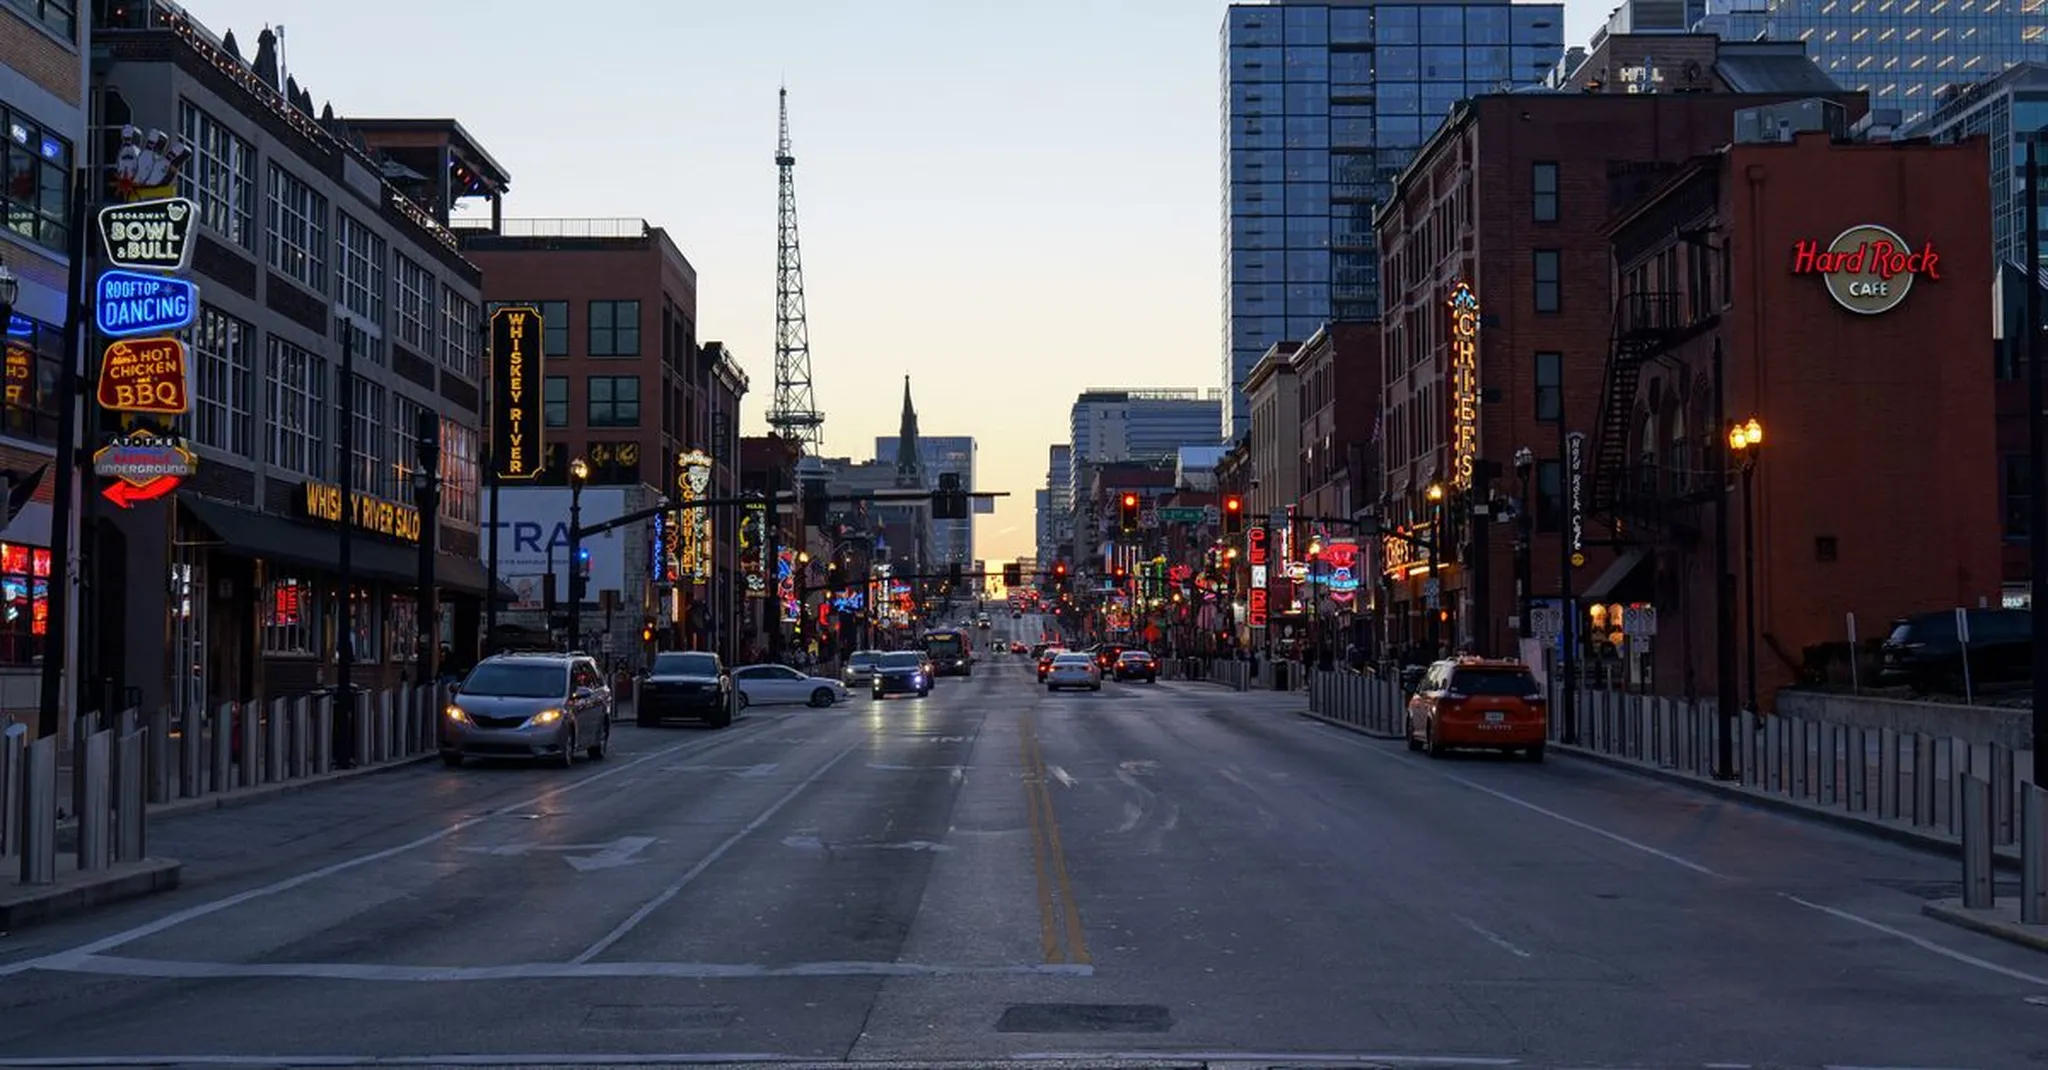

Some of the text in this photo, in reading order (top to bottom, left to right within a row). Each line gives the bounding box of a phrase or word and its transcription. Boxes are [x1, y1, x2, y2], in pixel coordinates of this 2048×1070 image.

[110, 221, 180, 241] BOWL
[117, 241, 179, 259] & BULL
[1793, 239, 1940, 280] Hard Rock
[105, 280, 160, 299] ROOFTOP
[1849, 281, 1889, 297] CAFE
[105, 295, 187, 326] DANCING
[140, 347, 173, 362] HOT
[110, 361, 177, 378] CHICKEN
[114, 381, 179, 407] BBQ
[508, 313, 525, 474] WHISKEY RIVER
[1457, 313, 1476, 477] CHIEFS
[111, 437, 174, 446] AT THE
[306, 481, 420, 542] WHISY RIVER SALO
